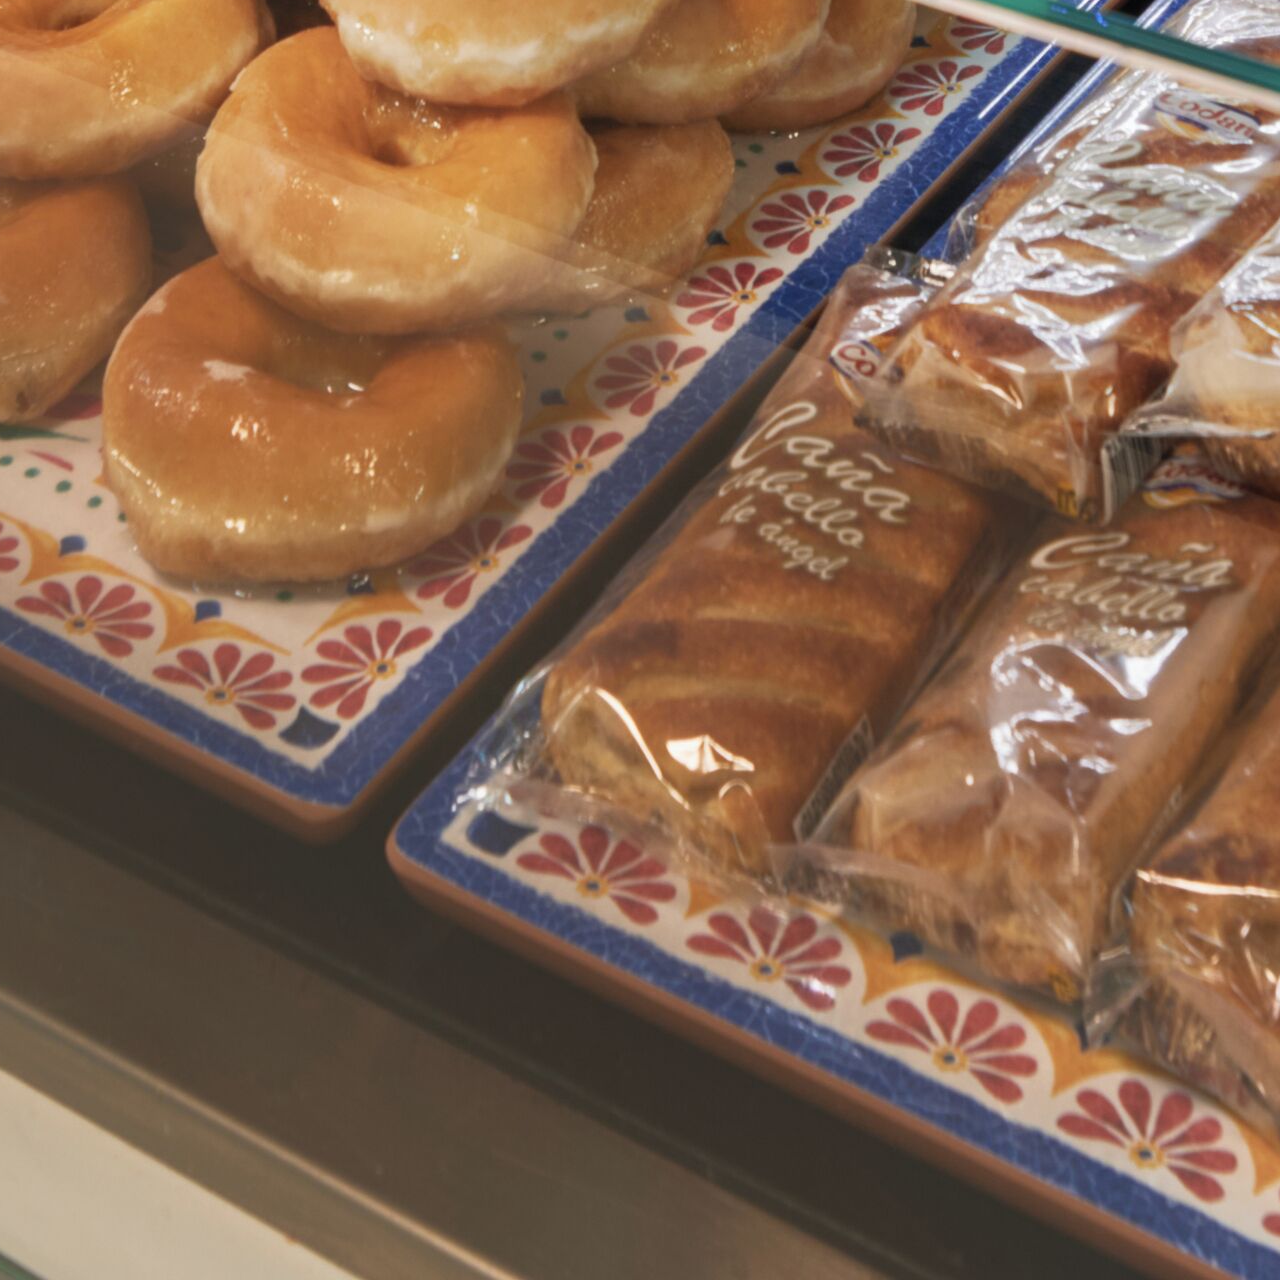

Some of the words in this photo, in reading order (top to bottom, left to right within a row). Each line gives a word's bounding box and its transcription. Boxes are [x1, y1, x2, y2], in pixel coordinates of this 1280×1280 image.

[730, 401, 911, 524] Caña
[757, 516, 850, 582] ángel
[1029, 532, 1235, 590] Caña
[1019, 574, 1188, 623] cabello
